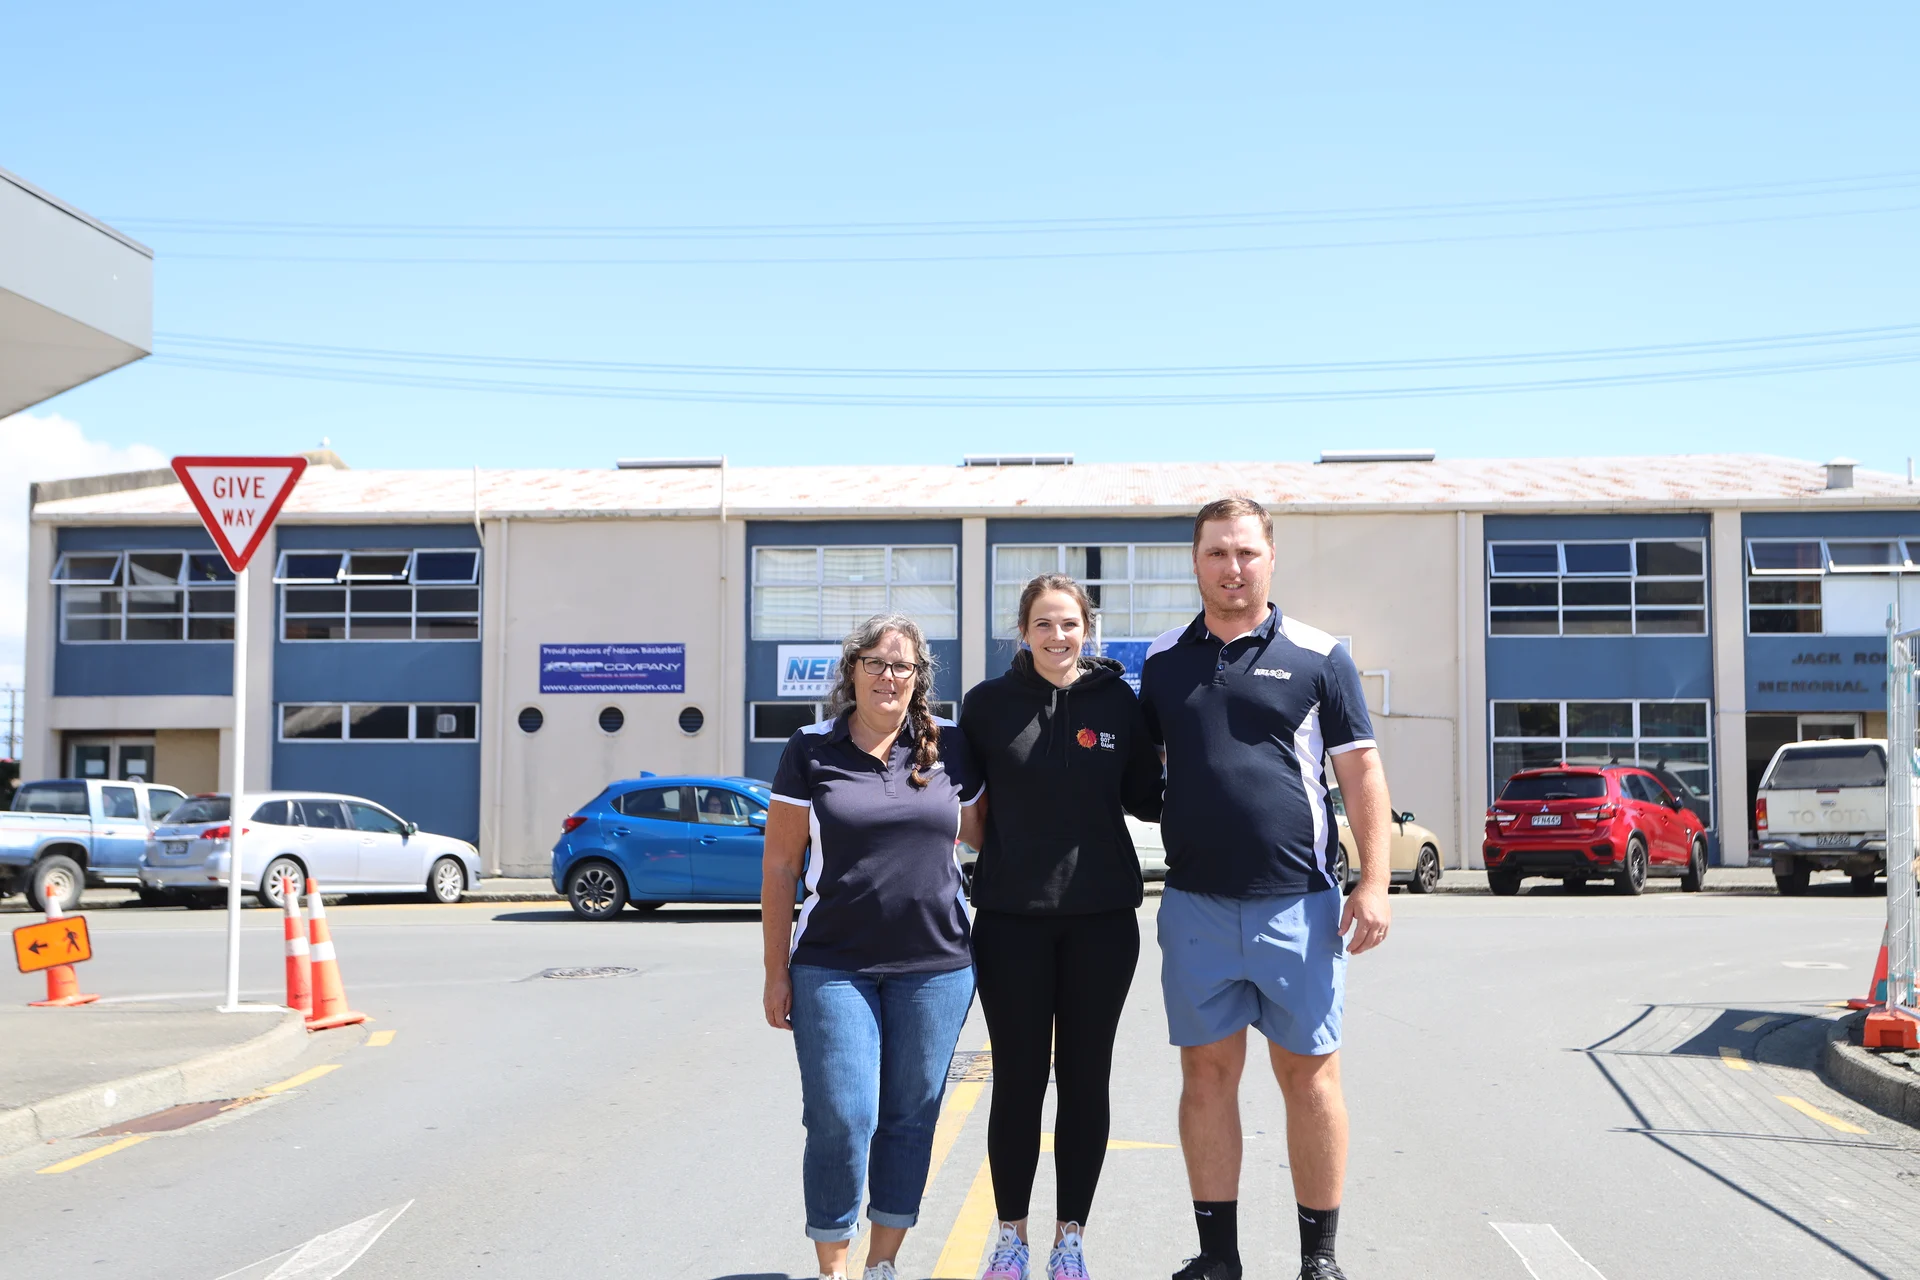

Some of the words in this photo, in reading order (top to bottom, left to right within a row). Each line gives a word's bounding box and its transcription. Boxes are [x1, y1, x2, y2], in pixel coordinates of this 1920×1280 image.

[213, 476, 265, 499] GIVE
[222, 508, 255, 527] WAY
[543, 646, 567, 655] Proud
[568, 648, 601, 656] sponsors
[602, 646, 612, 656] of
[612, 647, 640, 655] Nelson
[640, 646, 682, 654] Basketball
[1791, 653, 1842, 665] JACK
[1853, 652, 1887, 664] RO
[604, 662, 681, 671] COMPANY
[784, 656, 842, 682] NEL
[543, 684, 682, 692] www.carcompanynelson.co.nz
[1758, 681, 1869, 693] MEMORIAL
[1100, 732, 1115, 740] GIRLS
[1100, 742, 1115, 750] GAME
[1788, 809, 1872, 824] TOYOTA
